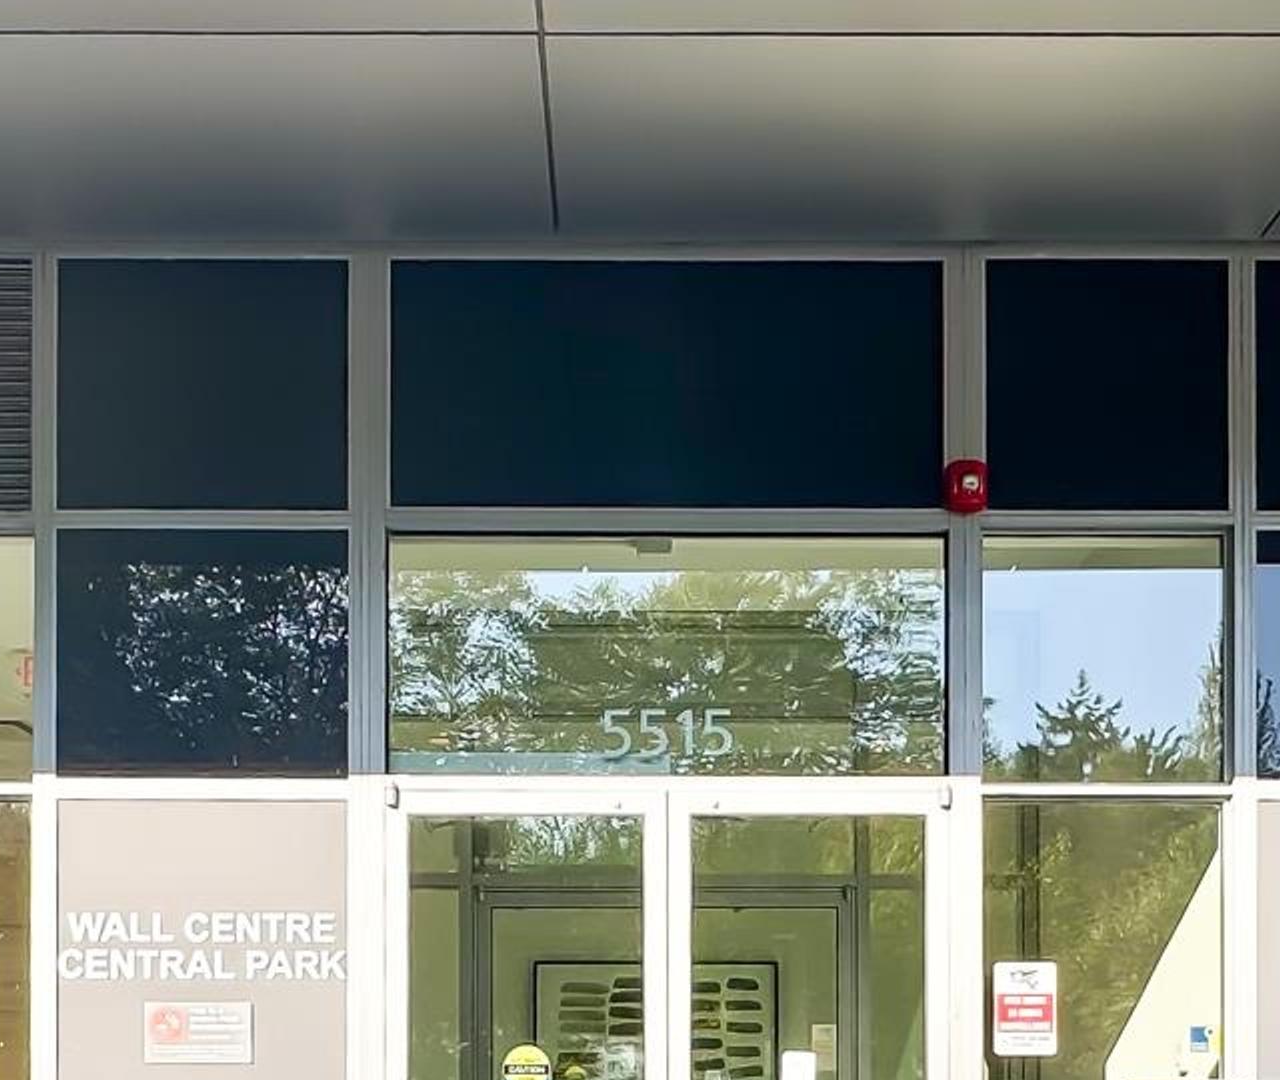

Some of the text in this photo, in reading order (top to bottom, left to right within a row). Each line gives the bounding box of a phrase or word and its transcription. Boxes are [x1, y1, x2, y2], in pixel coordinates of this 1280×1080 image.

[603, 708, 734, 758] 5515
[66, 911, 337, 944] WALL CENTRE
[58, 947, 349, 981] CENTRAL PARK
